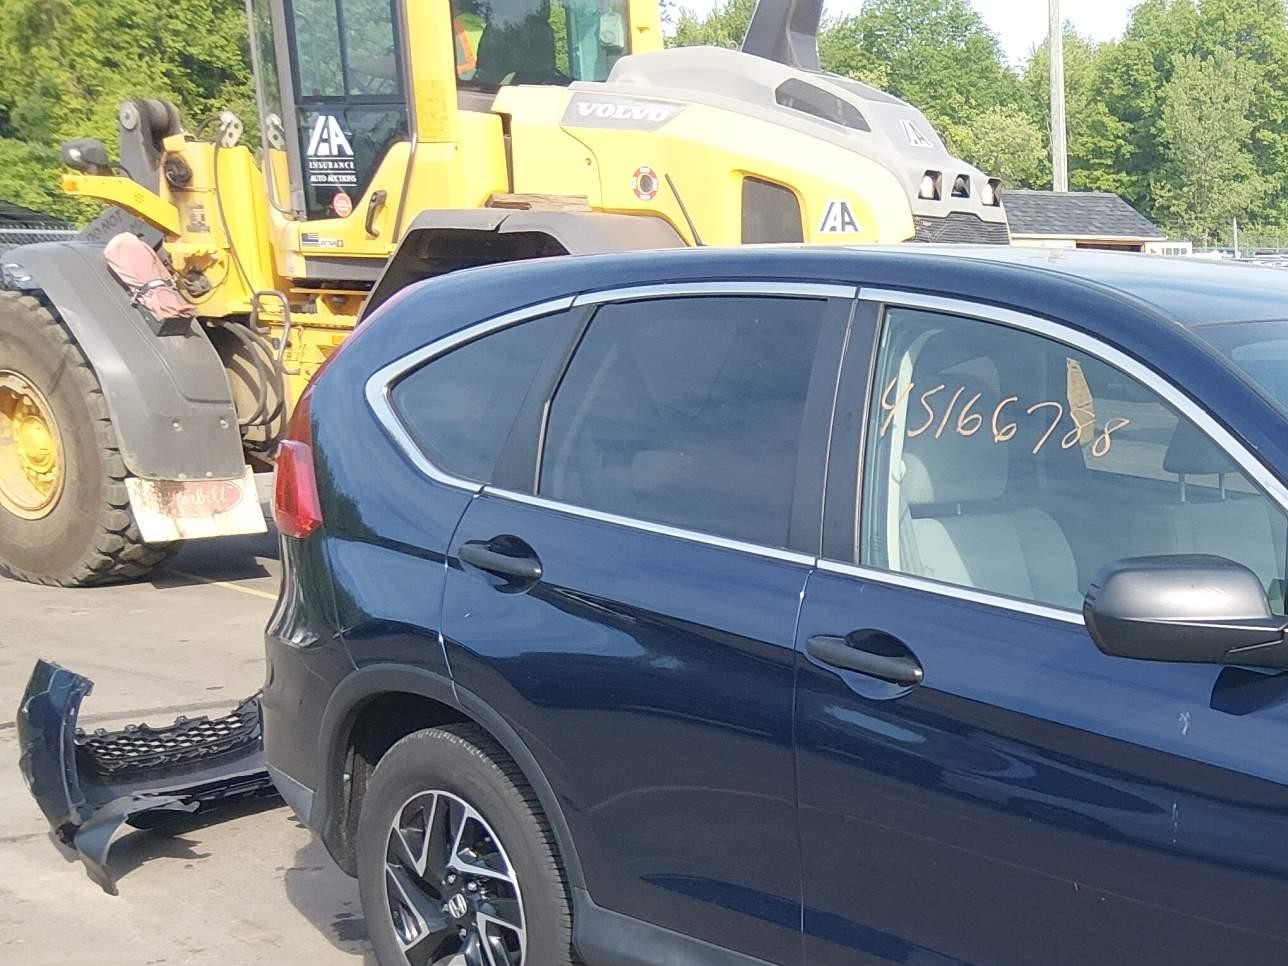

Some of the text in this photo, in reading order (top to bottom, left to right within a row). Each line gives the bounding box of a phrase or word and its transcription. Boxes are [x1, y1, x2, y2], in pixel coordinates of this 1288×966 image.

[577, 102, 671, 122] VOLVO
[308, 161, 355, 170] INSURANCE
[309, 174, 327, 183] AUTO
[327, 174, 357, 183] AUCTIONS
[880, 377, 1130, 457] 45166788
